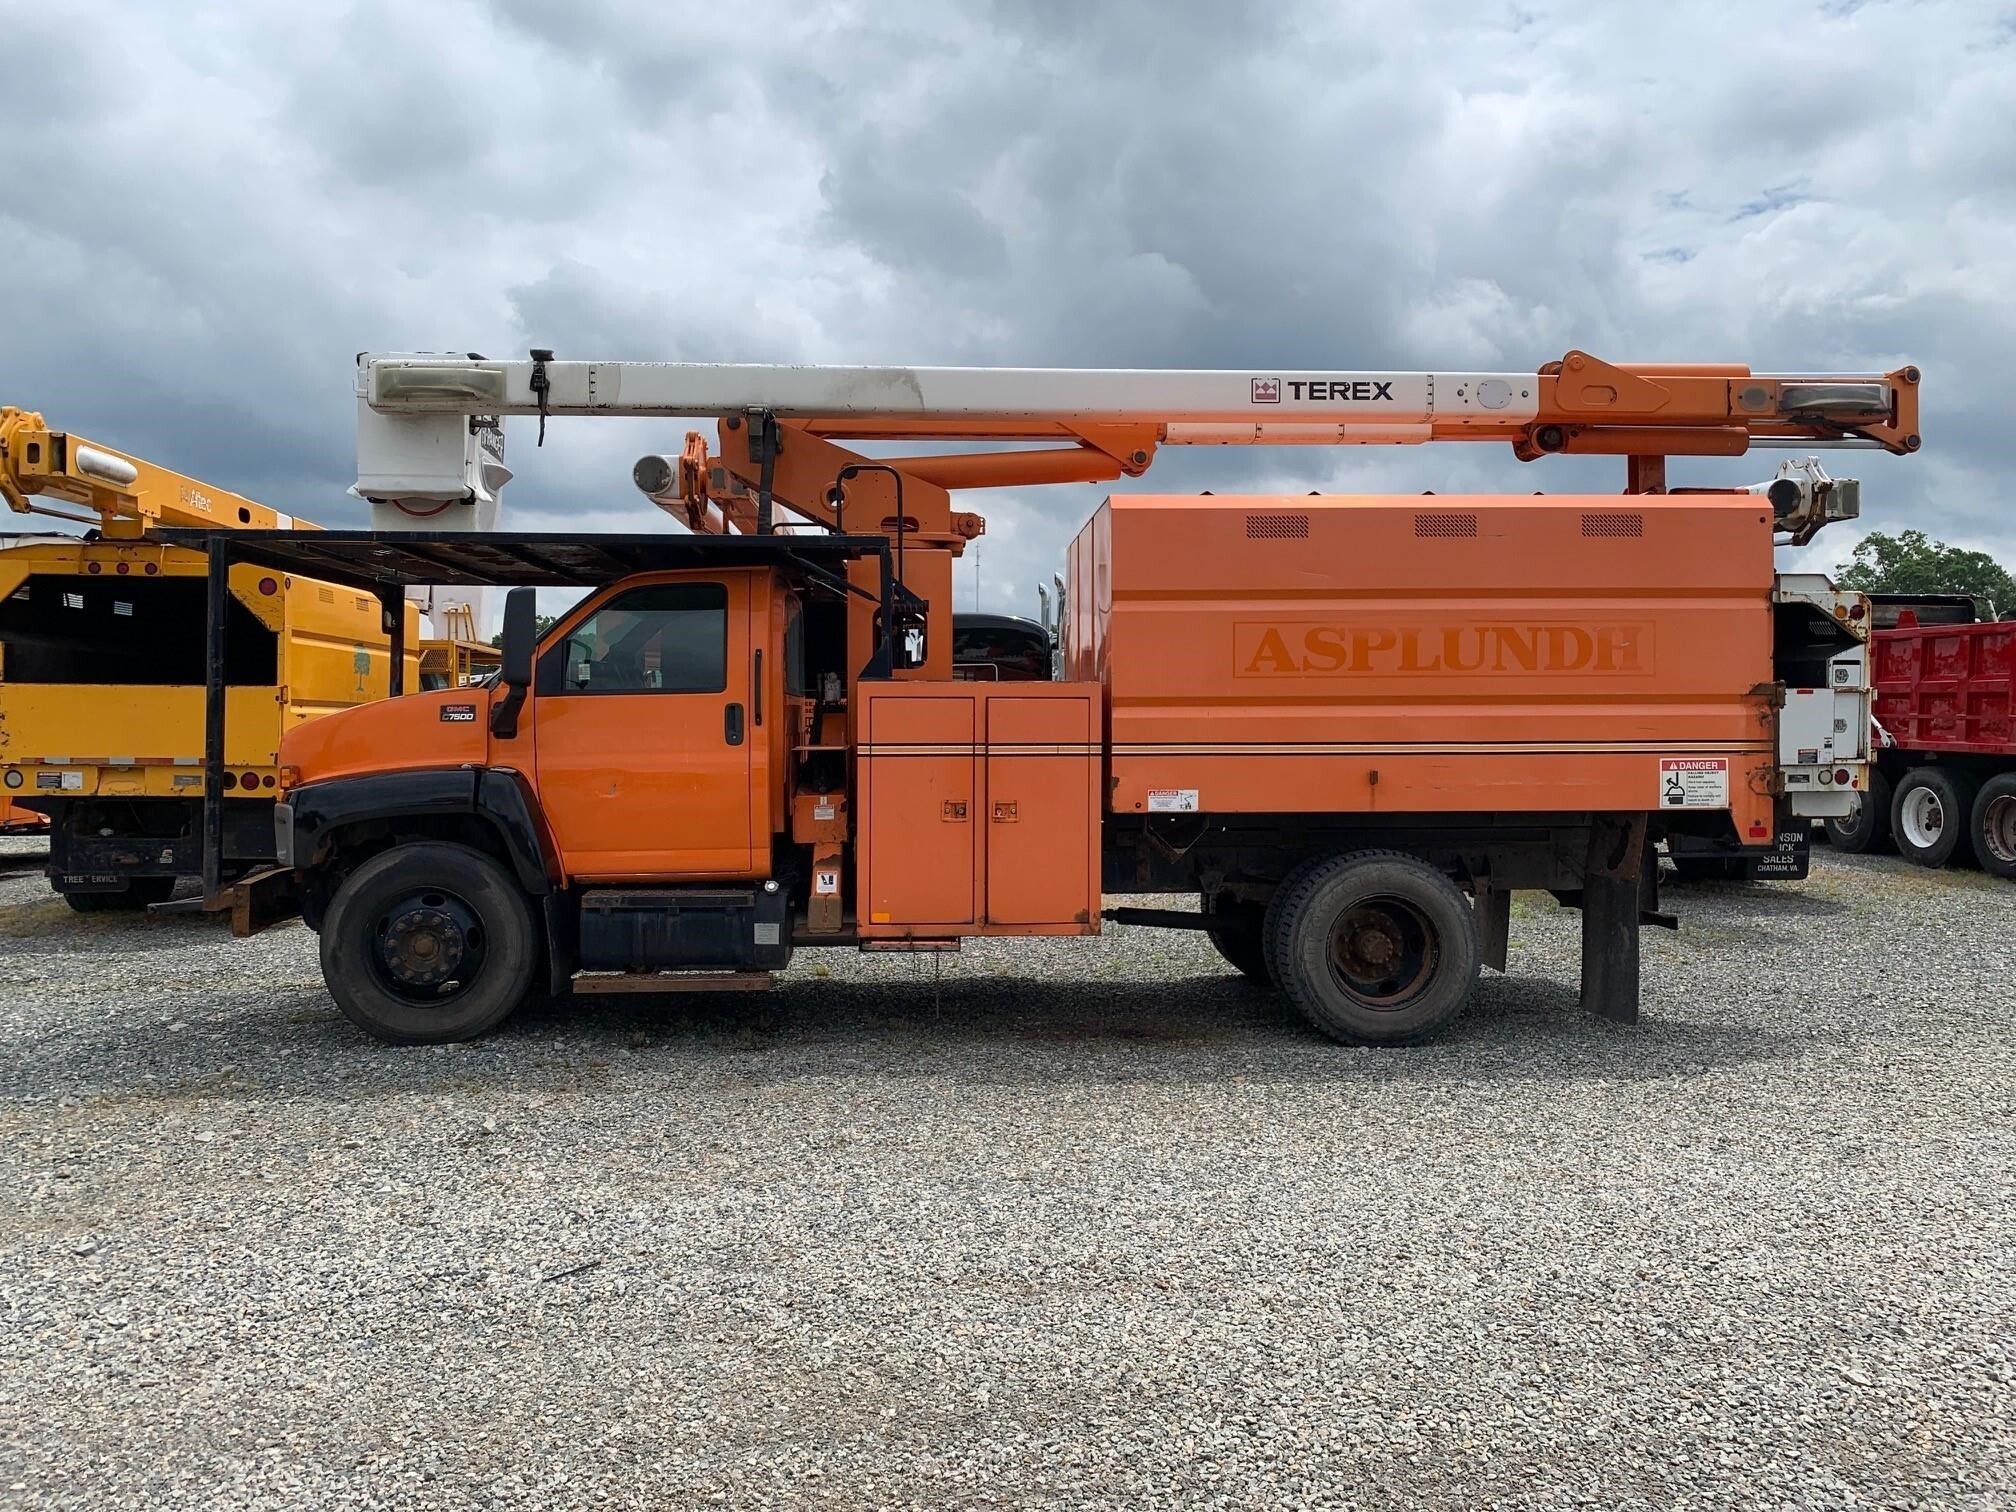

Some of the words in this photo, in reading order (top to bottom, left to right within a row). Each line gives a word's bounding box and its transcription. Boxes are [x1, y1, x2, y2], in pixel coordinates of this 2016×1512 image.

[1287, 381, 1394, 401] TEREX
[1244, 625, 1643, 673] ASPLUNDH
[442, 713, 474, 721] C7500
[1679, 761, 1719, 770] DANGER
[1763, 855, 1795, 864] SALES
[63, 875, 85, 884] TREE
